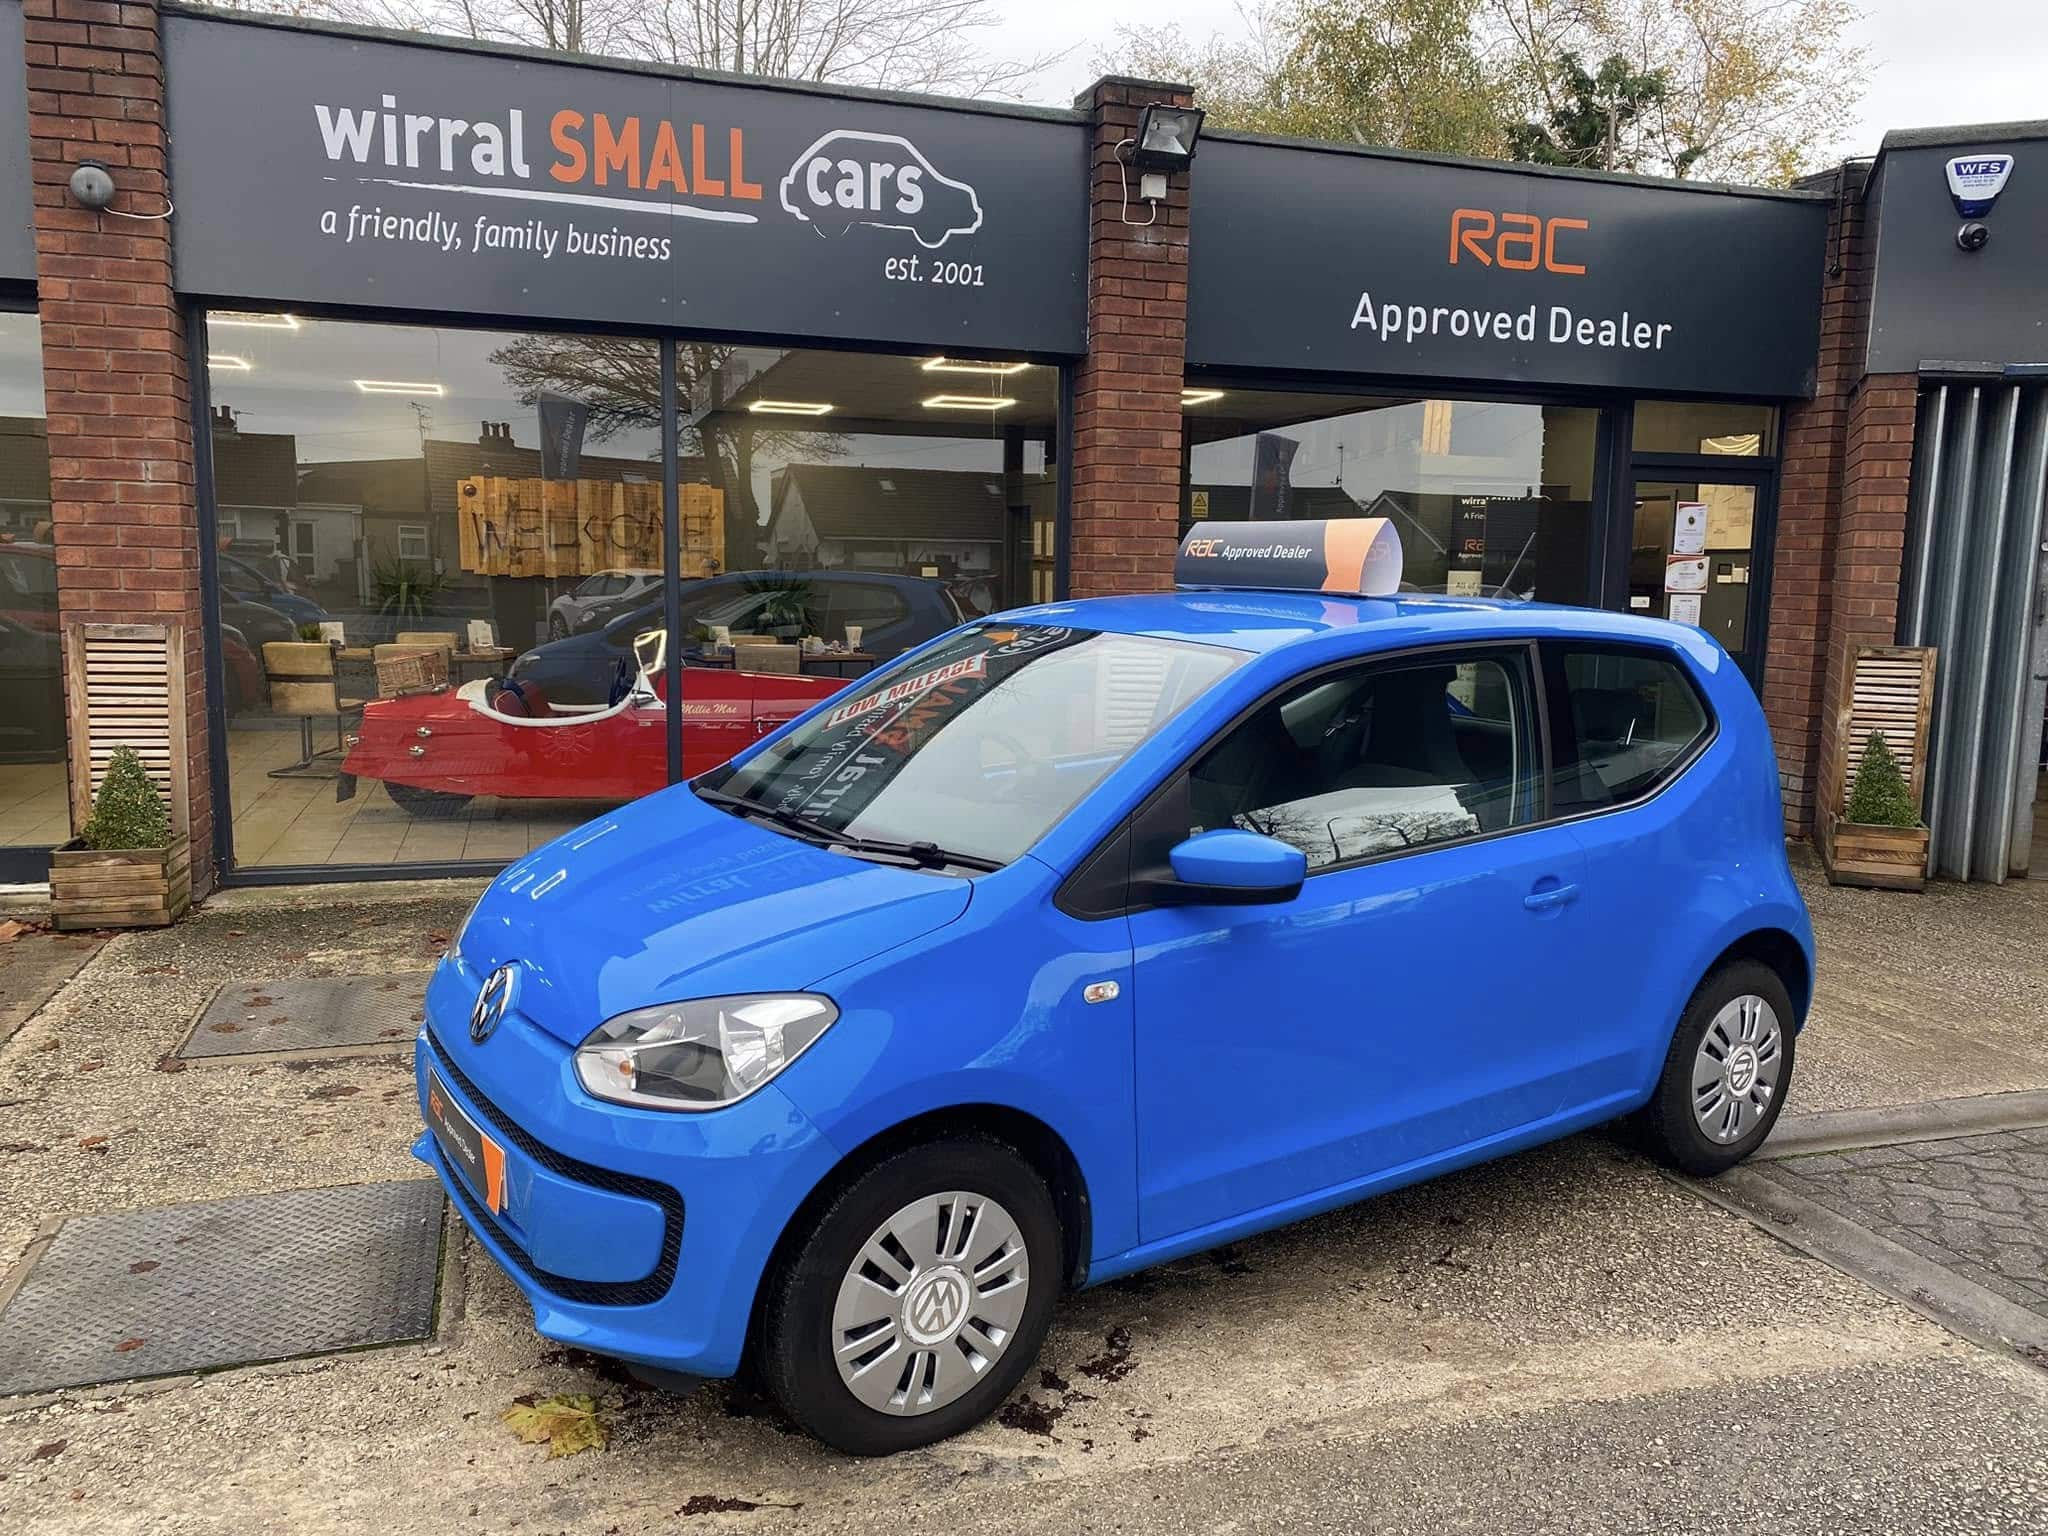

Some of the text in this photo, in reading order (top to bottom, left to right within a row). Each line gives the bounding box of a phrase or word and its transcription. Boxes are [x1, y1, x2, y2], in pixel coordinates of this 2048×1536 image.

[314, 94, 925, 216] wirral SMALL cars
[1961, 162, 2001, 174] WFS
[319, 204, 672, 262] a friendly, family business
[883, 253, 986, 288] est. 2001
[1350, 291, 1673, 350] Approved Dealer
[1221, 544, 1273, 560] Approved
[1272, 544, 1313, 559] Dealer
[836, 658, 977, 719] LOW MILEAGE
